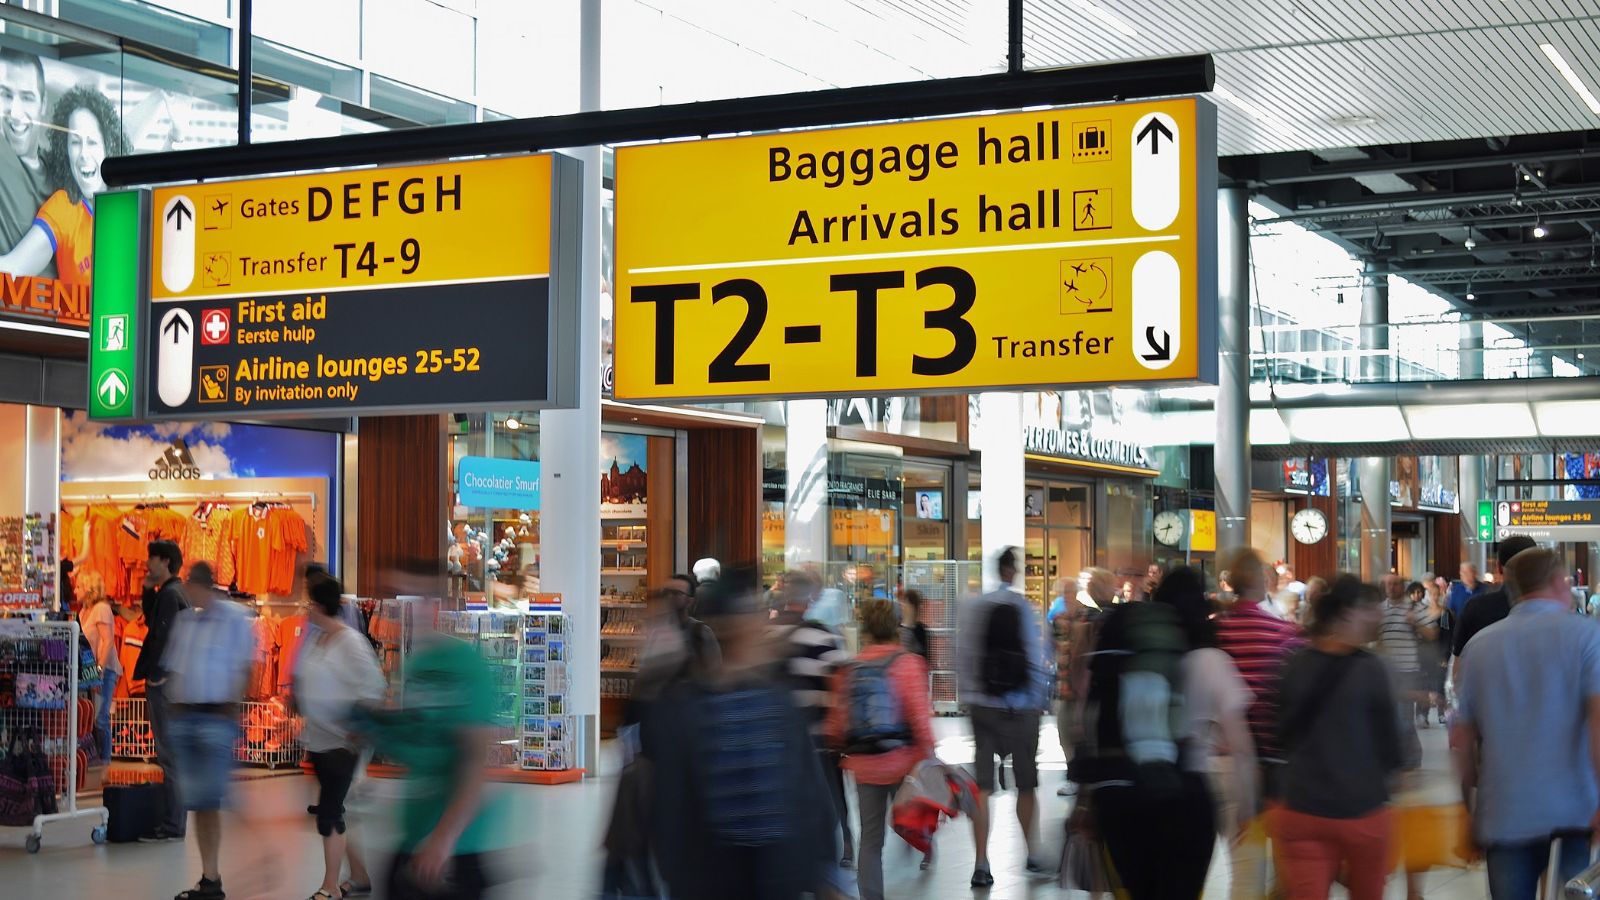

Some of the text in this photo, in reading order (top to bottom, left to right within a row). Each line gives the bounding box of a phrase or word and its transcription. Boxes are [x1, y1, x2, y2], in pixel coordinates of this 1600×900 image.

[769, 121, 1061, 188] Baggage hall
[240, 199, 299, 218] Gates
[787, 188, 1061, 246] Arrivals hall
[239, 238, 421, 279] Transfer T4-9
[238, 295, 327, 323] First aid
[237, 324, 316, 345] Eerste hulp
[630, 265, 1114, 386] T2-T3 Transfer
[235, 347, 480, 382] Airline lounges 25-52
[235, 381, 359, 404] By invitation only
[1091, 439, 1146, 465] COSMETICS
[148, 463, 201, 480] adidas
[464, 472, 513, 489] Chocolatier
[867, 488, 881, 499] ELIE
[917, 523, 940, 536] Skin
[4, 592, 40, 604] OFFER
